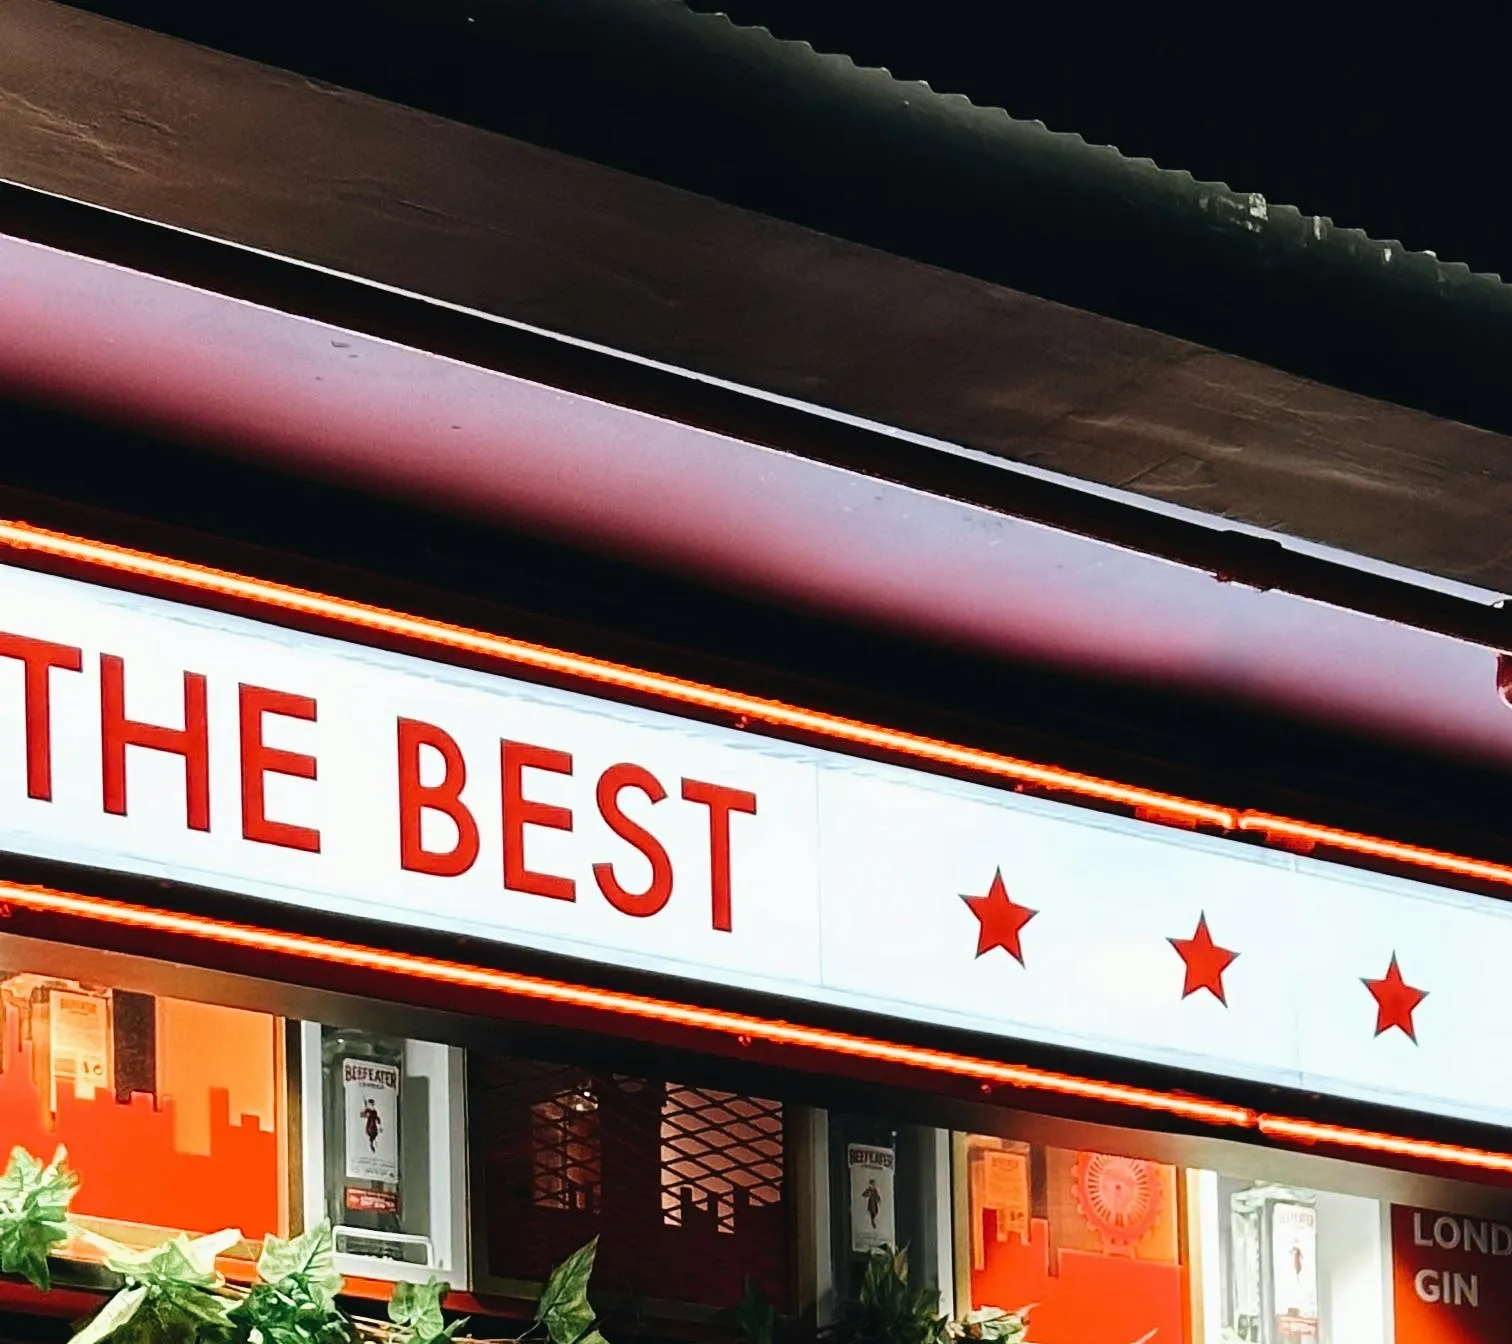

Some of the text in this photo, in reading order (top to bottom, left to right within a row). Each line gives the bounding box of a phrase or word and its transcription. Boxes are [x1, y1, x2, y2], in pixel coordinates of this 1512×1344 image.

[0, 631, 757, 933] THE BEST
[345, 1064, 397, 1089] BEEFEATER
[1414, 1267, 1479, 1308] GIN
